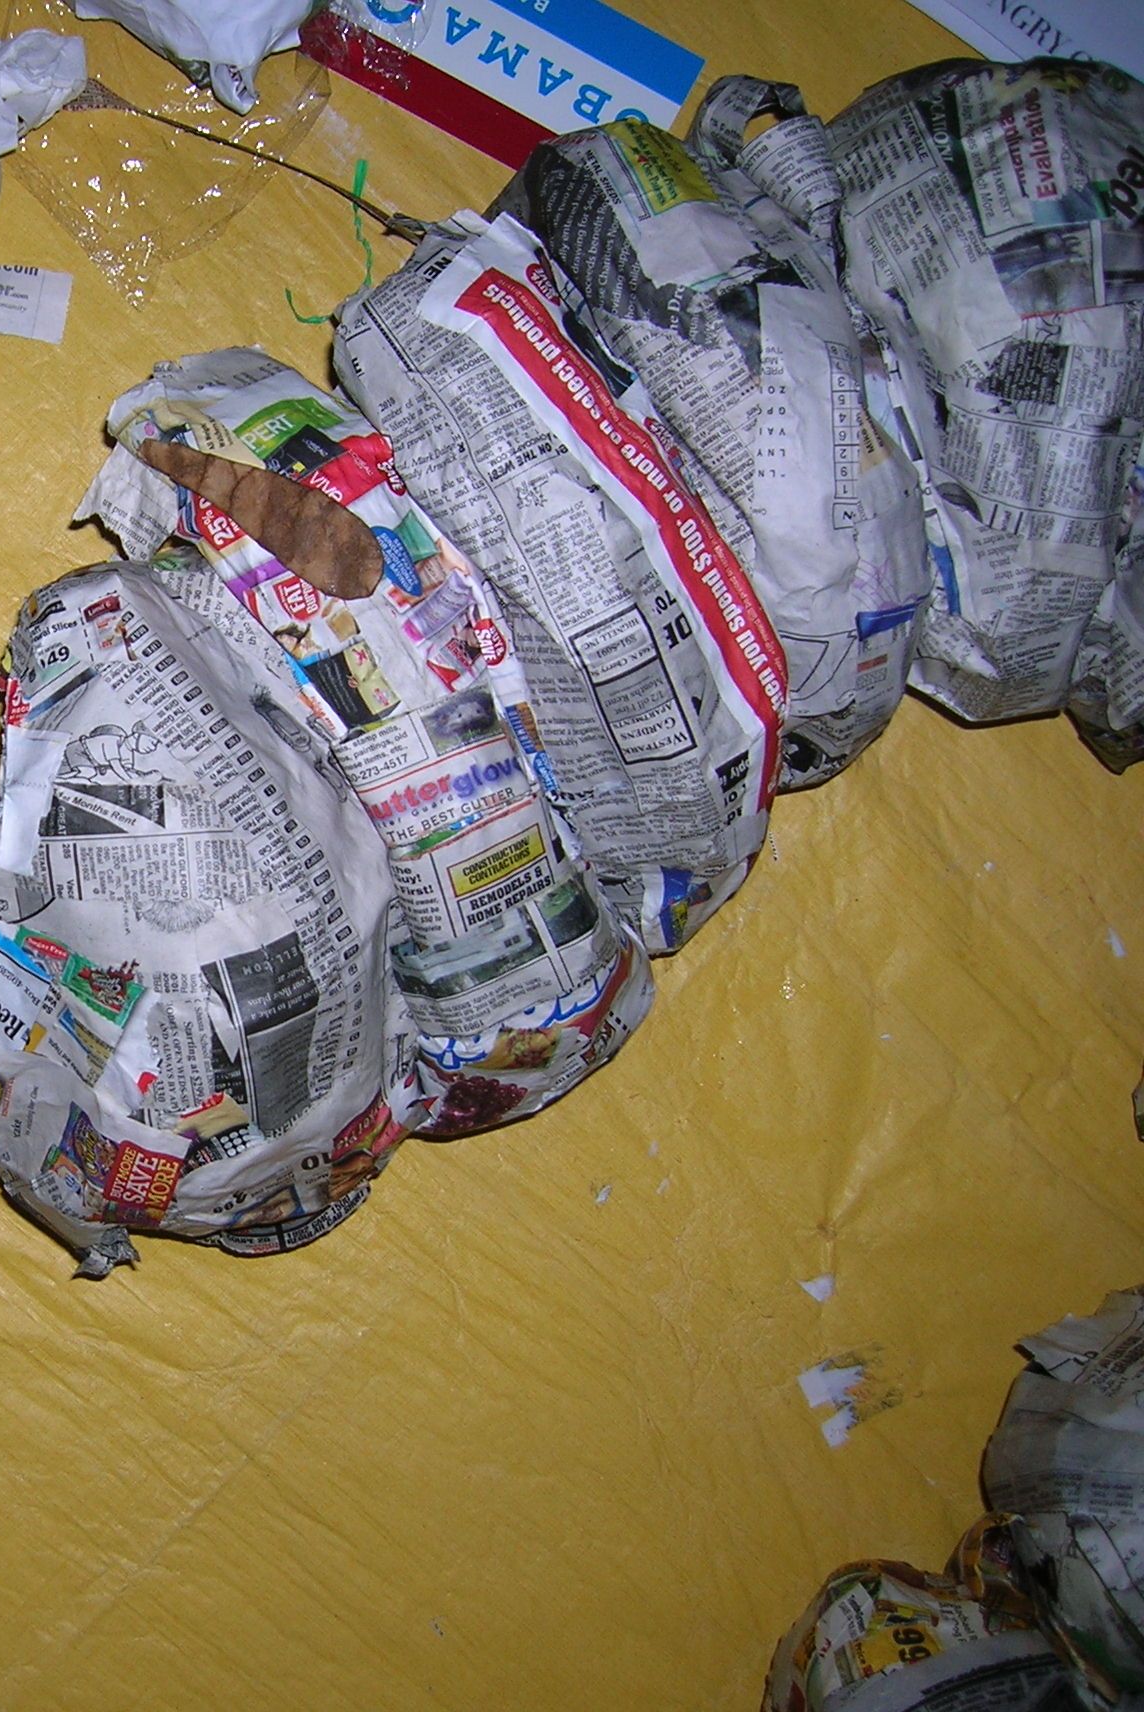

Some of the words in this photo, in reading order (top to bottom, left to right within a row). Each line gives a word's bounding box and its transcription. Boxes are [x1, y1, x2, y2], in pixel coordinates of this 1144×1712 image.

[599, 177, 622, 205] SHEDS
[572, 228, 588, 274] drawing
[482, 282, 561, 359] products
[555, 362, 600, 420] select
[538, 442, 552, 454] ON
[595, 416, 620, 446] on
[488, 461, 516, 482] WEB!
[517, 449, 538, 465] THE
[620, 443, 670, 494] more
[661, 488, 684, 514] or
[285, 584, 305, 620] FAT
[702, 569, 750, 629] spend
[52, 619, 78, 633] Slices
[394, 731, 408, 742] old
[71, 795, 110, 818] Months
[111, 811, 137, 827] Rent
[387, 826, 417, 848] THE
[422, 809, 456, 831] BEST
[461, 787, 515, 814] GUTTER
[462, 835, 530, 877] CONSTRUCTION/
[468, 847, 531, 885] CONTRACTORS
[179, 860, 187, 898] GILFORD
[470, 869, 532, 911] REMODELS
[466, 902, 503, 926] HOME
[505, 874, 552, 910] REPAIRS
[183, 1020, 197, 1061] Starting
[110, 1177, 126, 1198] BUY
[119, 1148, 138, 1178] MORE
[122, 1152, 159, 1204] SAVE
[146, 1159, 179, 1210] MORE
